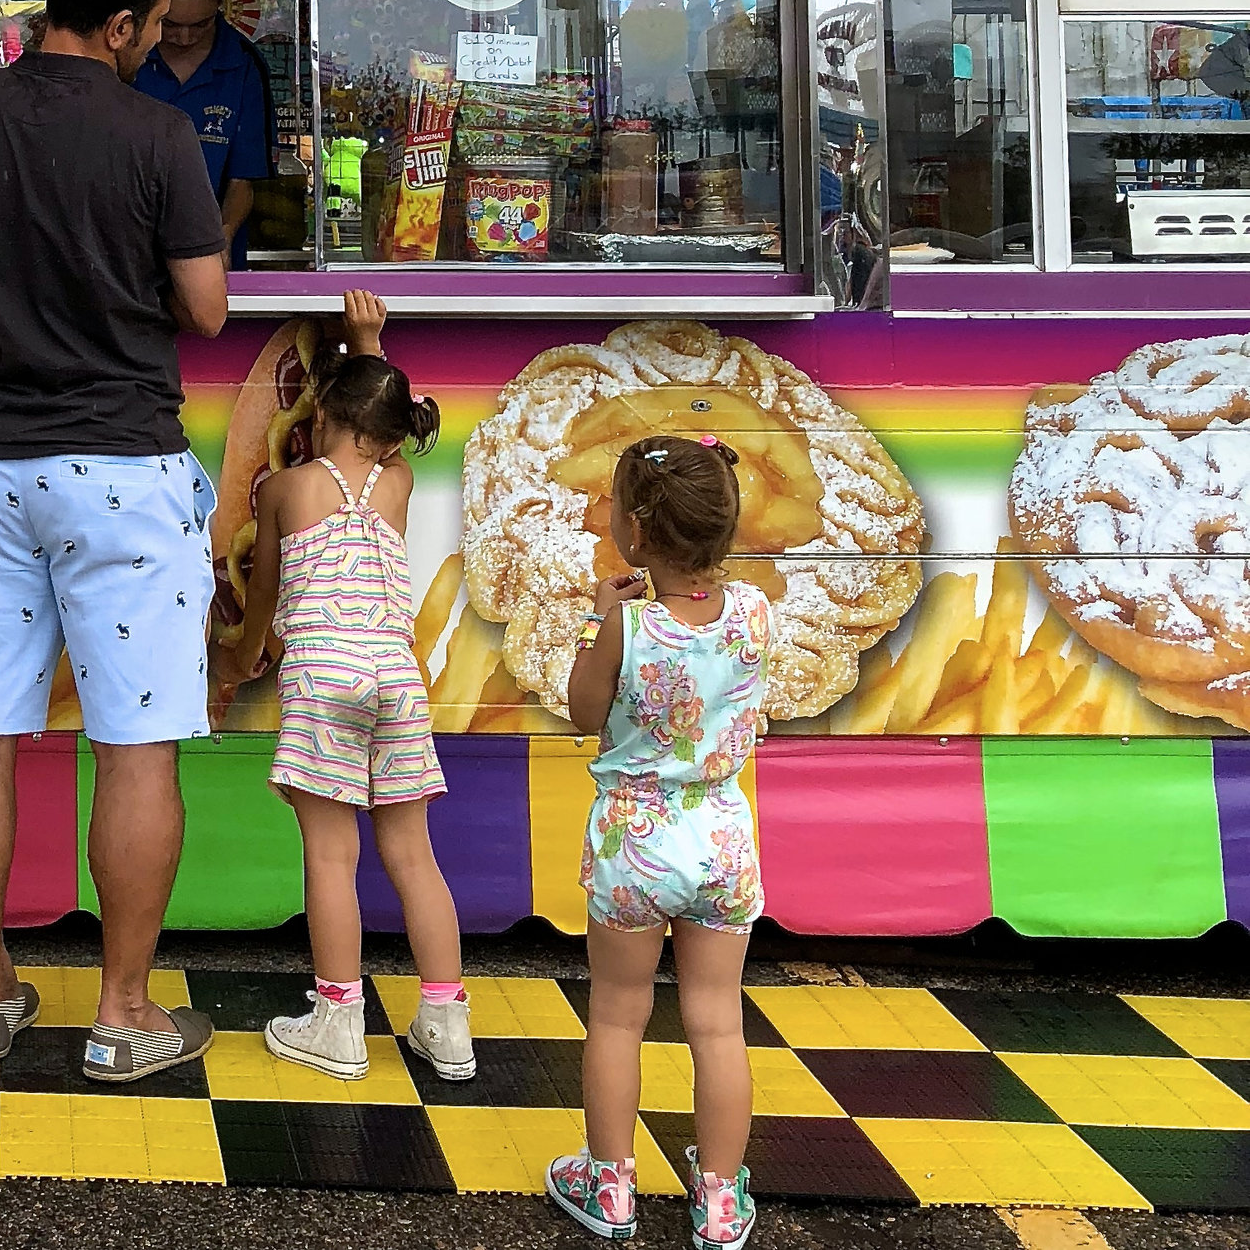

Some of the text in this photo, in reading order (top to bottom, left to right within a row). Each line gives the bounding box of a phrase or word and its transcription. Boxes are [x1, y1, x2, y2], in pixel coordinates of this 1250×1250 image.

[462, 34, 495, 45] $10
[474, 66, 519, 80] Cards
[412, 131, 446, 143] ORIGINAL
[499, 206, 523, 223] 44
